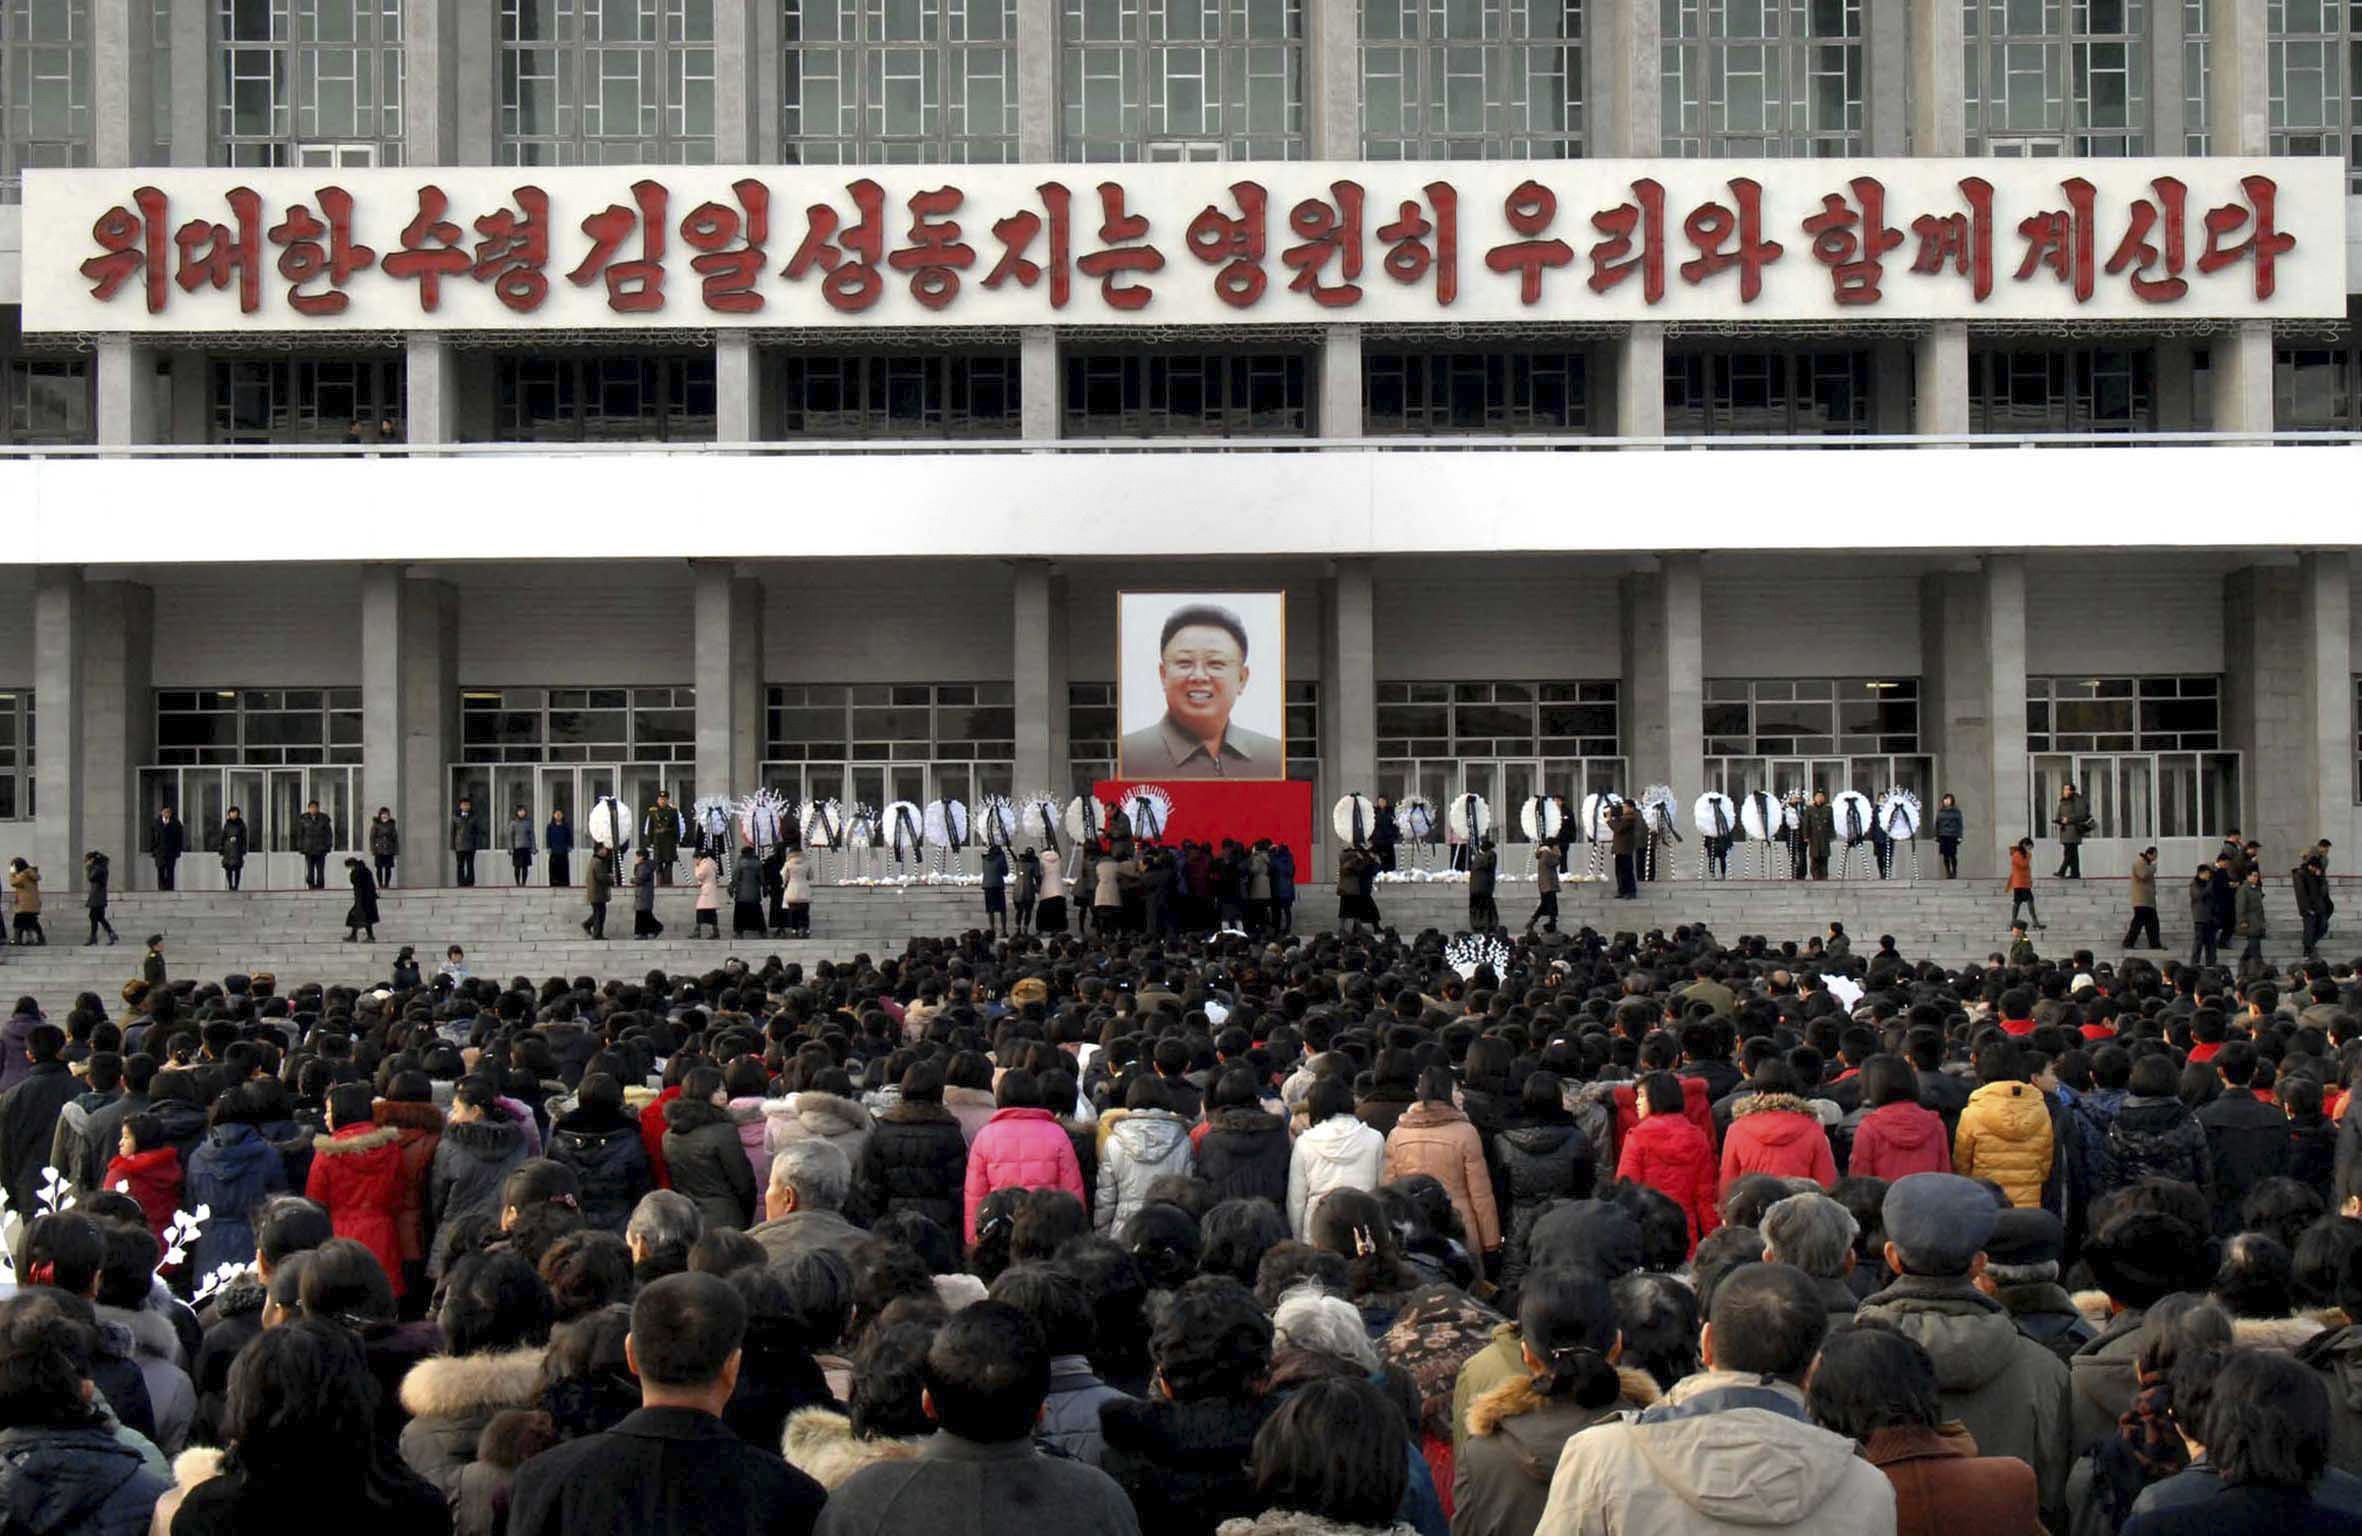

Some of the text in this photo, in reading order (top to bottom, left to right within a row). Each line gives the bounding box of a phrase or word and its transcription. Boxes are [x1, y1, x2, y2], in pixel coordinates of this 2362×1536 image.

[79, 185, 376, 315] 위대한
[380, 184, 550, 315] 수령
[1185, 179, 1458, 311] 영원히
[1484, 177, 1784, 307] 우리와
[1801, 176, 1995, 308] 함께
[2012, 174, 2297, 305] 계신다
